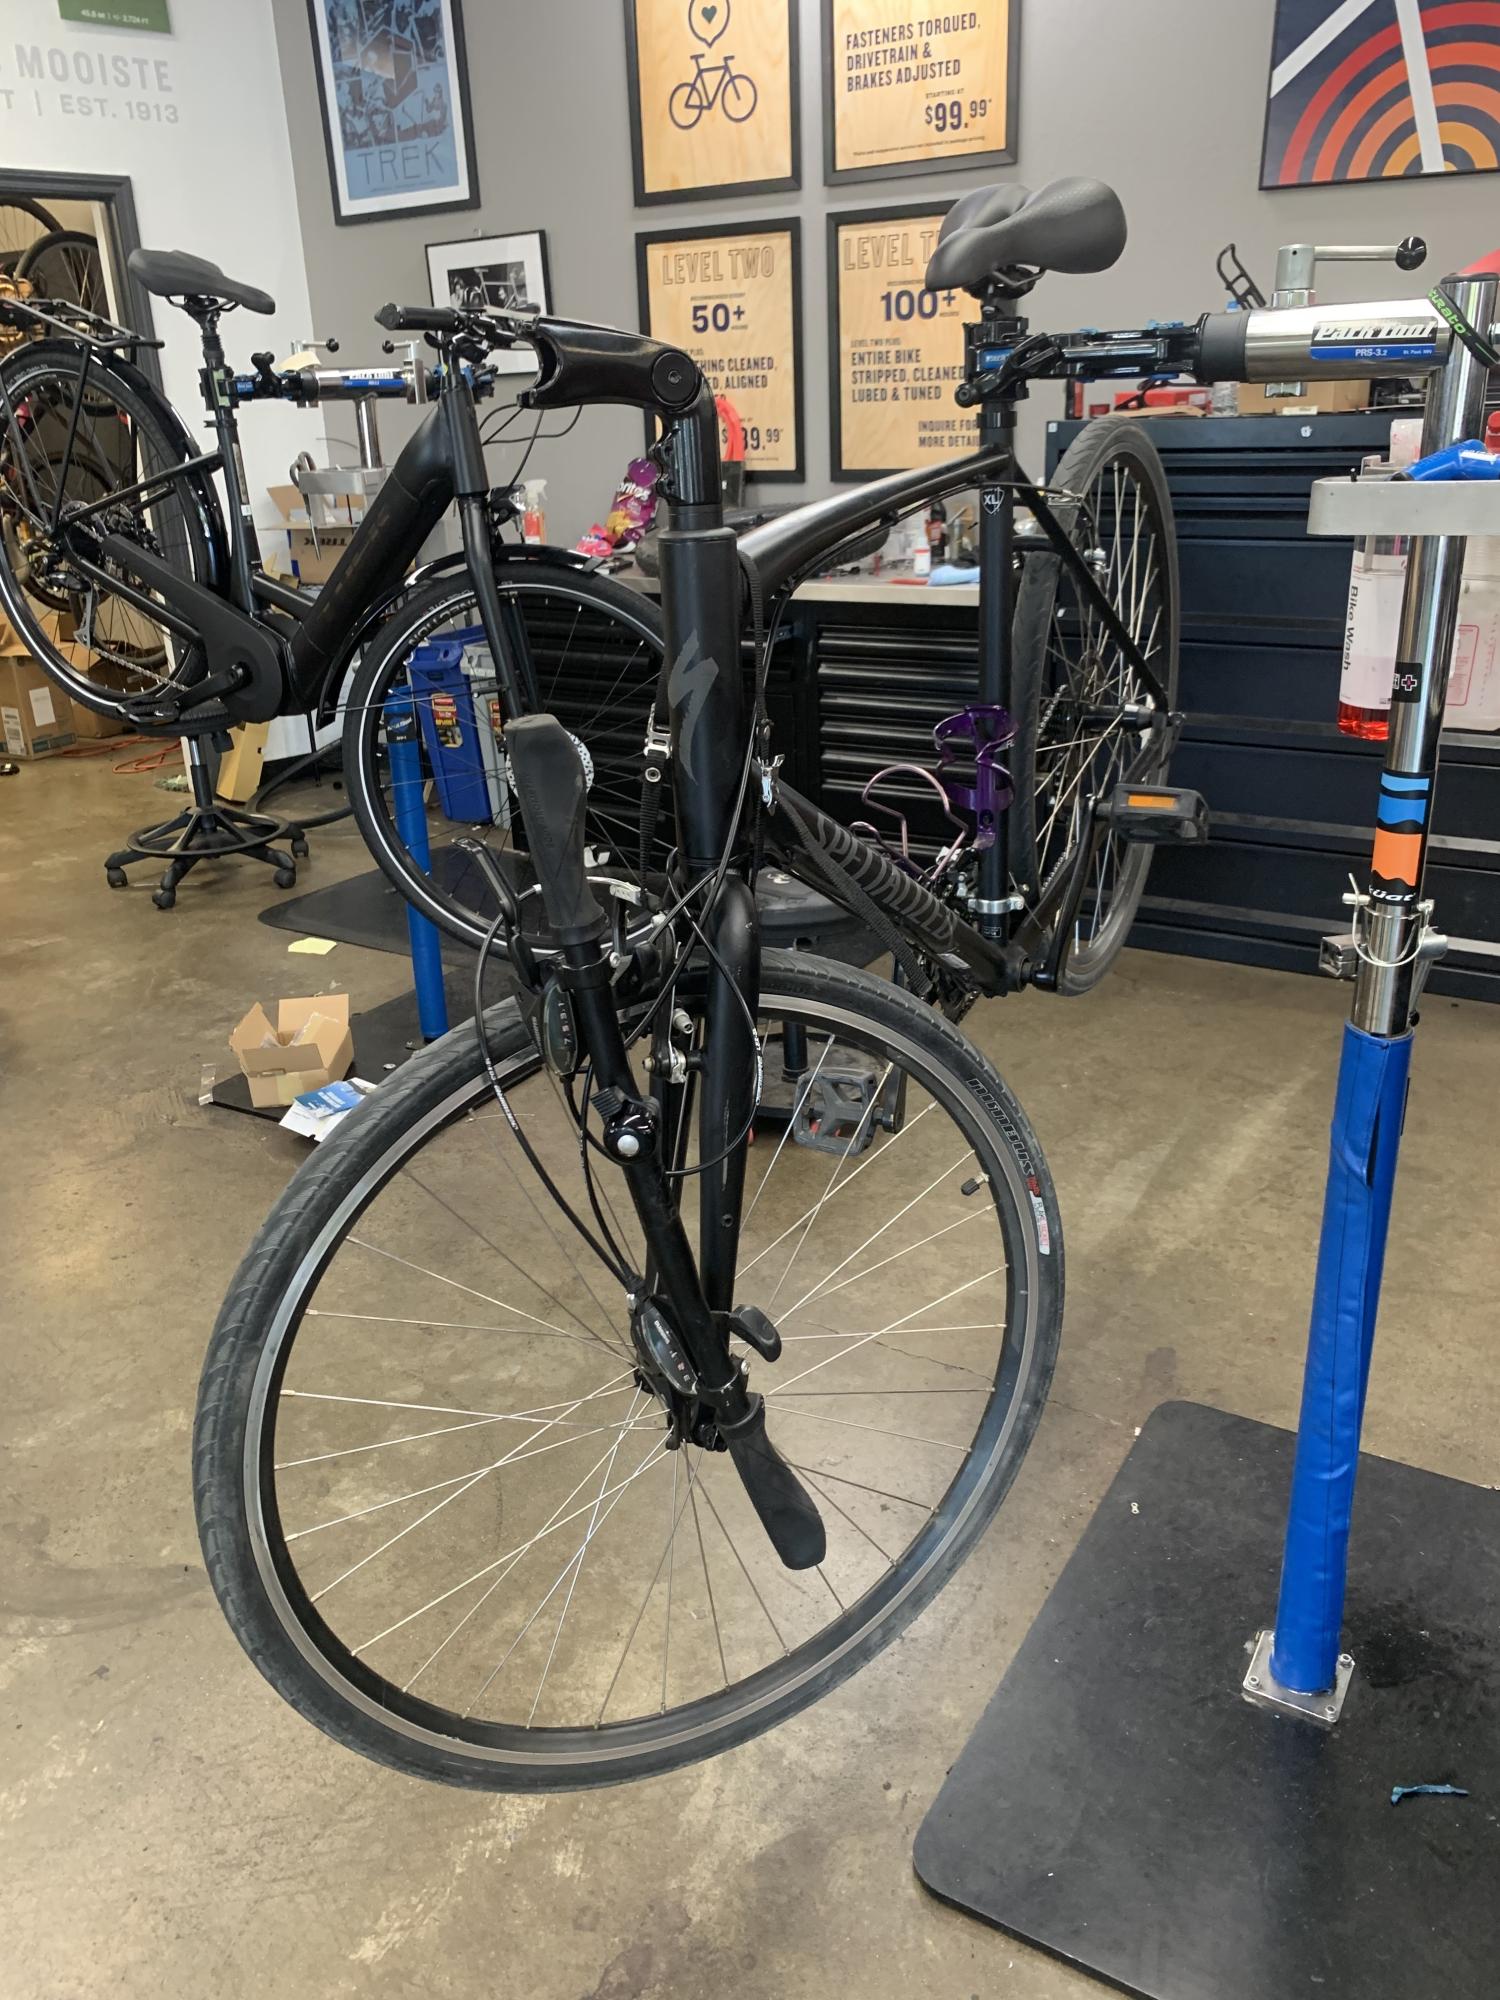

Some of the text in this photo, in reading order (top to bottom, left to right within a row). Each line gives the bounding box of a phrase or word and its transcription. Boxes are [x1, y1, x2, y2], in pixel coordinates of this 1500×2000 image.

[846, 12, 981, 50] FASTENERS TORQUED,
[15, 44, 173, 93] MOOISTE
[846, 42, 932, 72] DRIVETRAIN &
[847, 59, 961, 93] BRAKES ADJUSTED
[59, 93, 117, 118] EST.
[125, 100, 180, 124] 1913
[356, 141, 445, 185] TREK
[662, 246, 775, 286] LEVEL TWO
[843, 233, 914, 271] LEVEL
[692, 303, 745, 334] 50+
[880, 289, 956, 321] 100+
[727, 356, 778, 372] CLEANED,
[851, 349, 921, 366] ENTIRE BIKE
[1355, 348, 1388, 357] PRS-3.2
[725, 375, 768, 389] ALIGNED
[851, 368, 910, 385] STRIPPED,
[852, 385, 942, 403] LUBED & TUNED
[918, 419, 956, 432] INQUIRE
[918, 435, 945, 448] MORE
[617, 481, 651, 501] oritos
[983, 494, 1000, 505] XL
[1342, 585, 1359, 671] Bike Wash
[817, 812, 958, 941] SPECIALIZED
